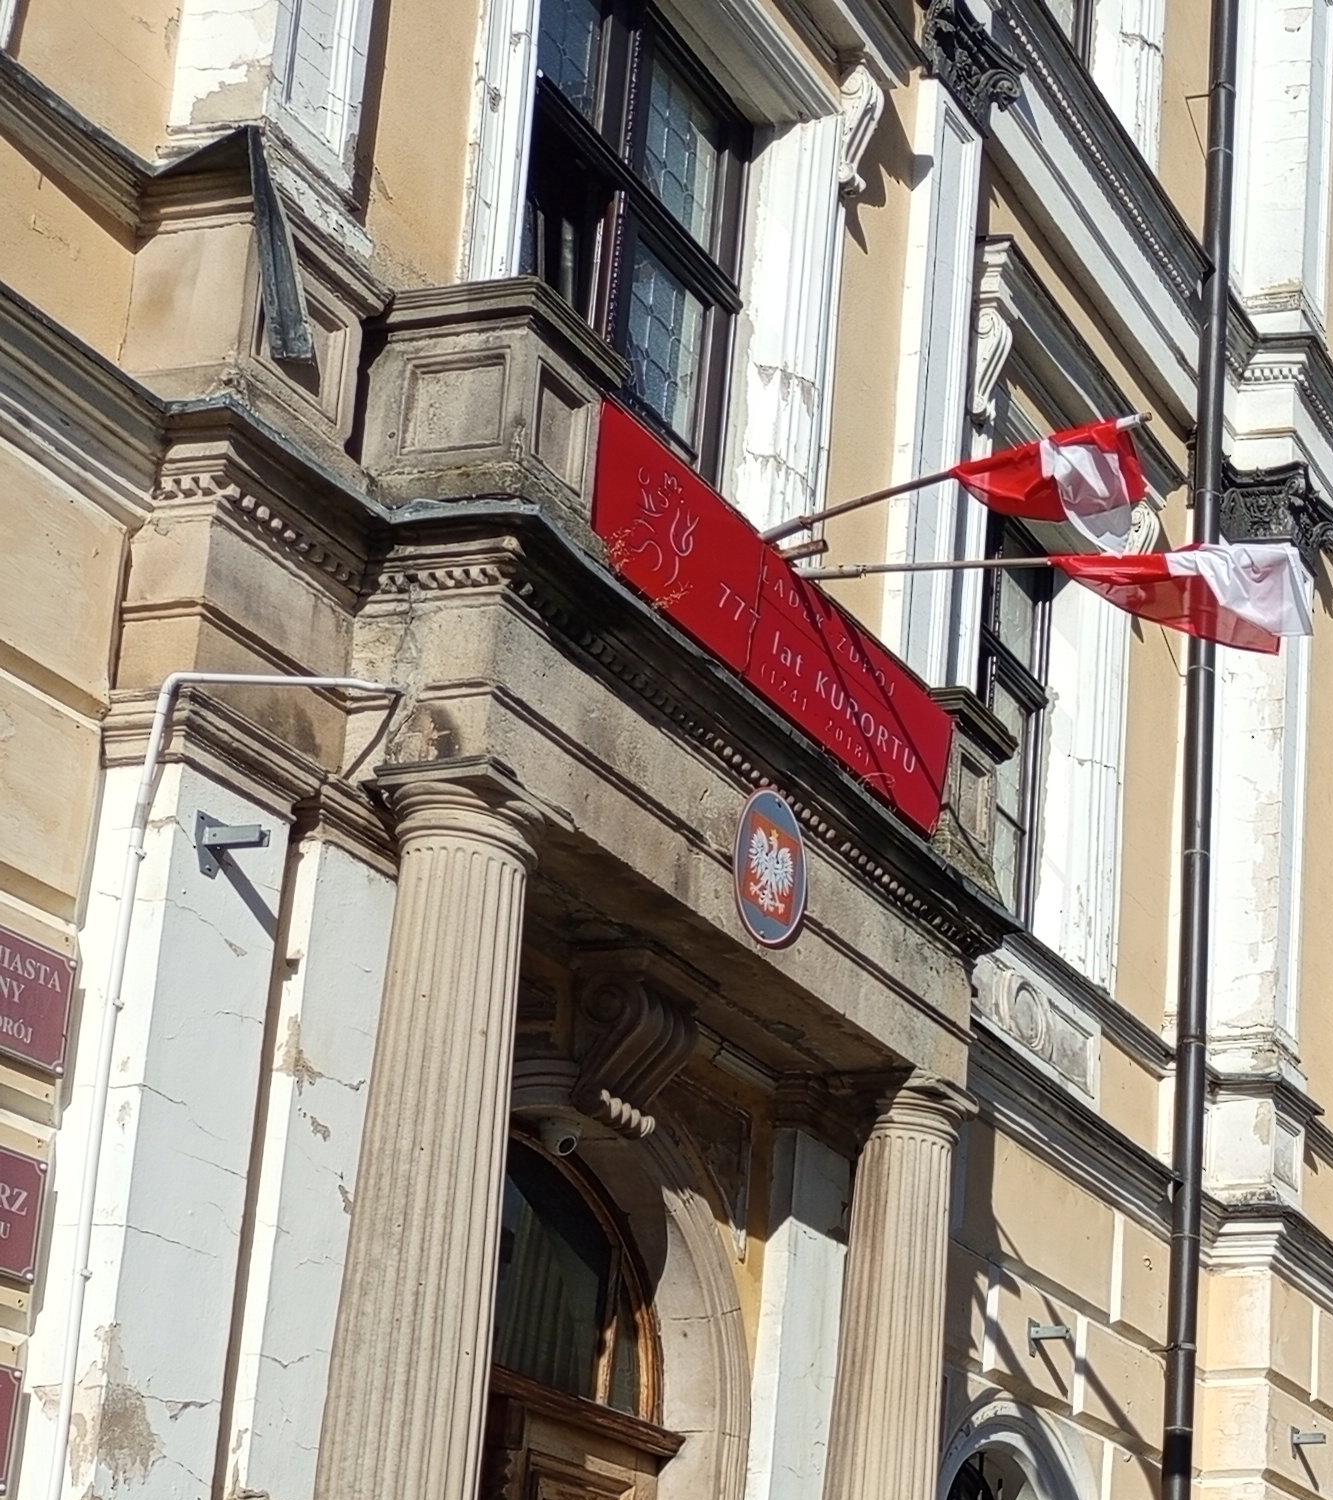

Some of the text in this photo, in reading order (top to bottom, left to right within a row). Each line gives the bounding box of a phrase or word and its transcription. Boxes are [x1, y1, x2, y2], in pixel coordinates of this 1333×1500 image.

[720, 582, 916, 774] 777 lat KURORTU
